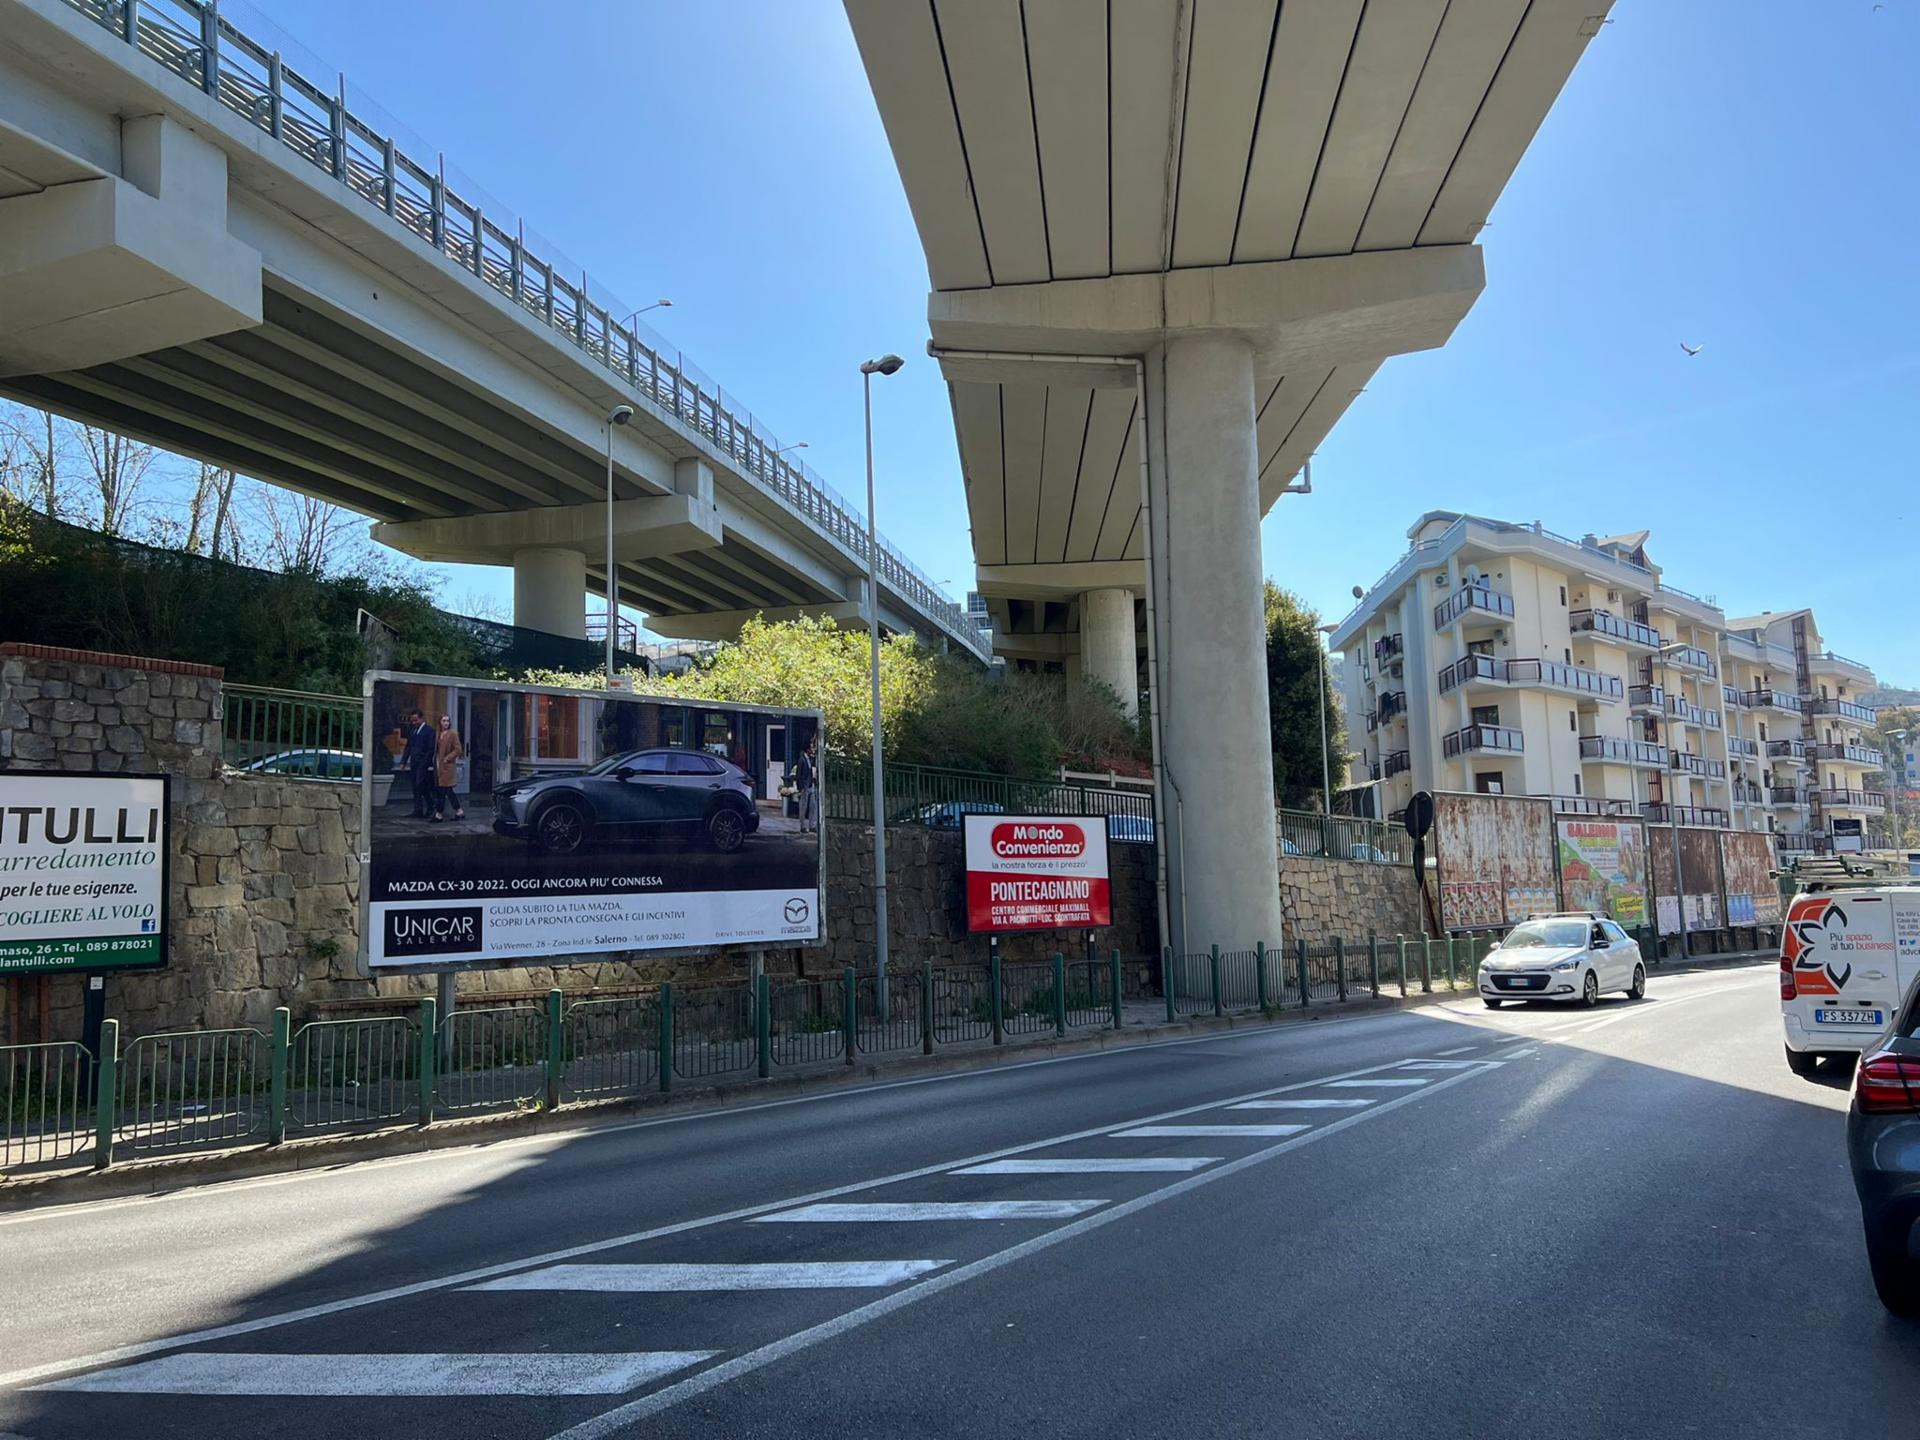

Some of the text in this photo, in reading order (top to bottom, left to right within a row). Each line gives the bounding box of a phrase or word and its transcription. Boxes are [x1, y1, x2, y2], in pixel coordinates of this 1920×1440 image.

[0, 806, 159, 845] TULLI
[1013, 825, 1064, 840] Mondo
[996, 840, 1081, 855] Convenienza
[1027, 861, 1047, 869] forza
[1060, 861, 1086, 869] prezzo
[0, 880, 138, 901] per le tue esigenze.
[388, 881, 435, 892] MAZDA
[438, 880, 474, 891] CX-30
[477, 879, 508, 890] 2022.
[511, 878, 540, 889] OGGI
[542, 877, 588, 889] ANCORA
[612, 876, 663, 887] CONNESSA
[990, 880, 1090, 902] PONTECAGNANO
[86, 905, 109, 922] AL
[112, 903, 155, 919] VOLO
[489, 905, 520, 915] GUIDA
[522, 904, 555, 914] SUBITO
[556, 904, 568, 913] LA
[569, 903, 586, 912] TUA
[991, 903, 1090, 915] CENTRO COMMERCIALE MAXIMALL
[394, 915, 474, 937] UNICAR
[489, 911, 685, 928] SCOPRI LA PRONTA CONSEGNA E GLI INCENTIVI
[396, 934, 475, 945] SALERNO
[594, 935, 628, 945] Salerno
[1840, 942, 1854, 950] tuo
[36, 944, 52, 955] 26
[62, 943, 84, 953] Tel.
[86, 942, 109, 952] 089
[111, 940, 153, 950] 878021
[1823, 1011, 1837, 1021] FS
